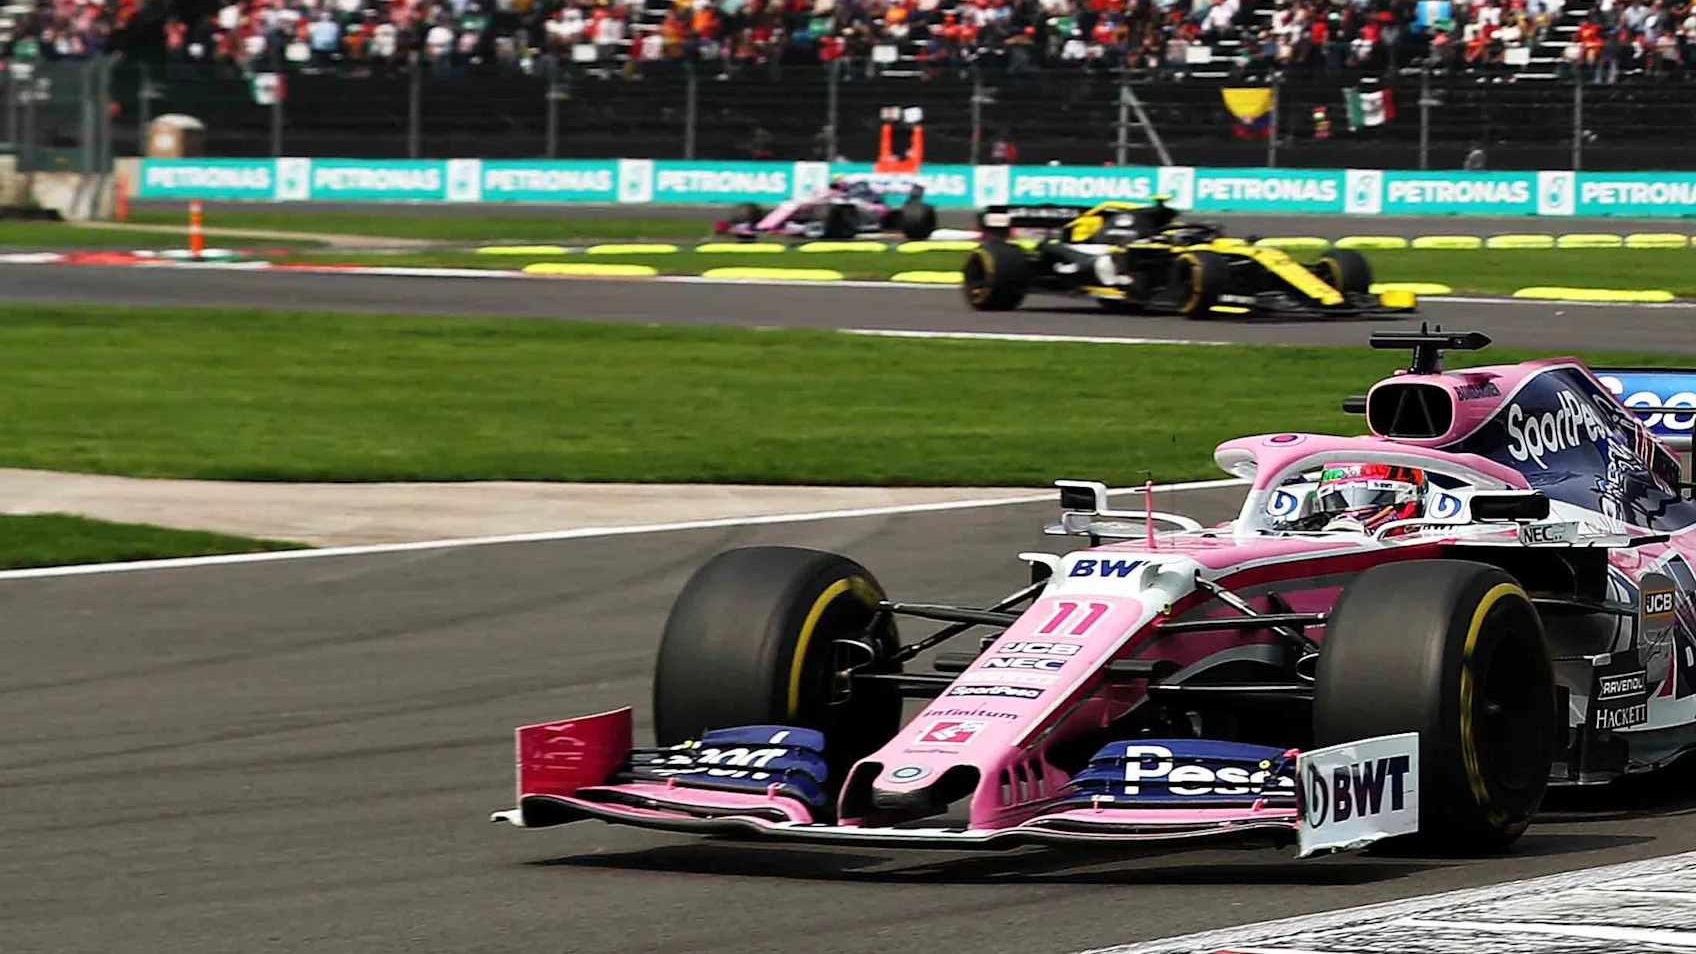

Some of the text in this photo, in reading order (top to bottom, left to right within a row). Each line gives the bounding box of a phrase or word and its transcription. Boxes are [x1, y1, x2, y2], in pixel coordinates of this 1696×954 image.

[147, 167, 271, 189] PETRONAS
[314, 168, 441, 191] PETRONAS
[484, 169, 612, 192] PETRONAS
[657, 170, 787, 194] PETRONAS
[1014, 175, 1150, 198] PETRONAS
[1197, 177, 1337, 202] PETRONAS
[1389, 180, 1529, 203] PETRONAS
[1508, 390, 1607, 470] SportPes
[1524, 525, 1554, 544] NEC
[1068, 560, 1151, 578] BW
[1646, 593, 1673, 613] JCB
[1039, 602, 1109, 636] 11
[997, 642, 1084, 656] JCB
[981, 657, 1067, 671] NEC
[1603, 677, 1644, 695] RAVENOL
[924, 708, 1019, 720] infinitum
[1596, 704, 1647, 730] HACKETT
[1333, 754, 1410, 824] BWT
